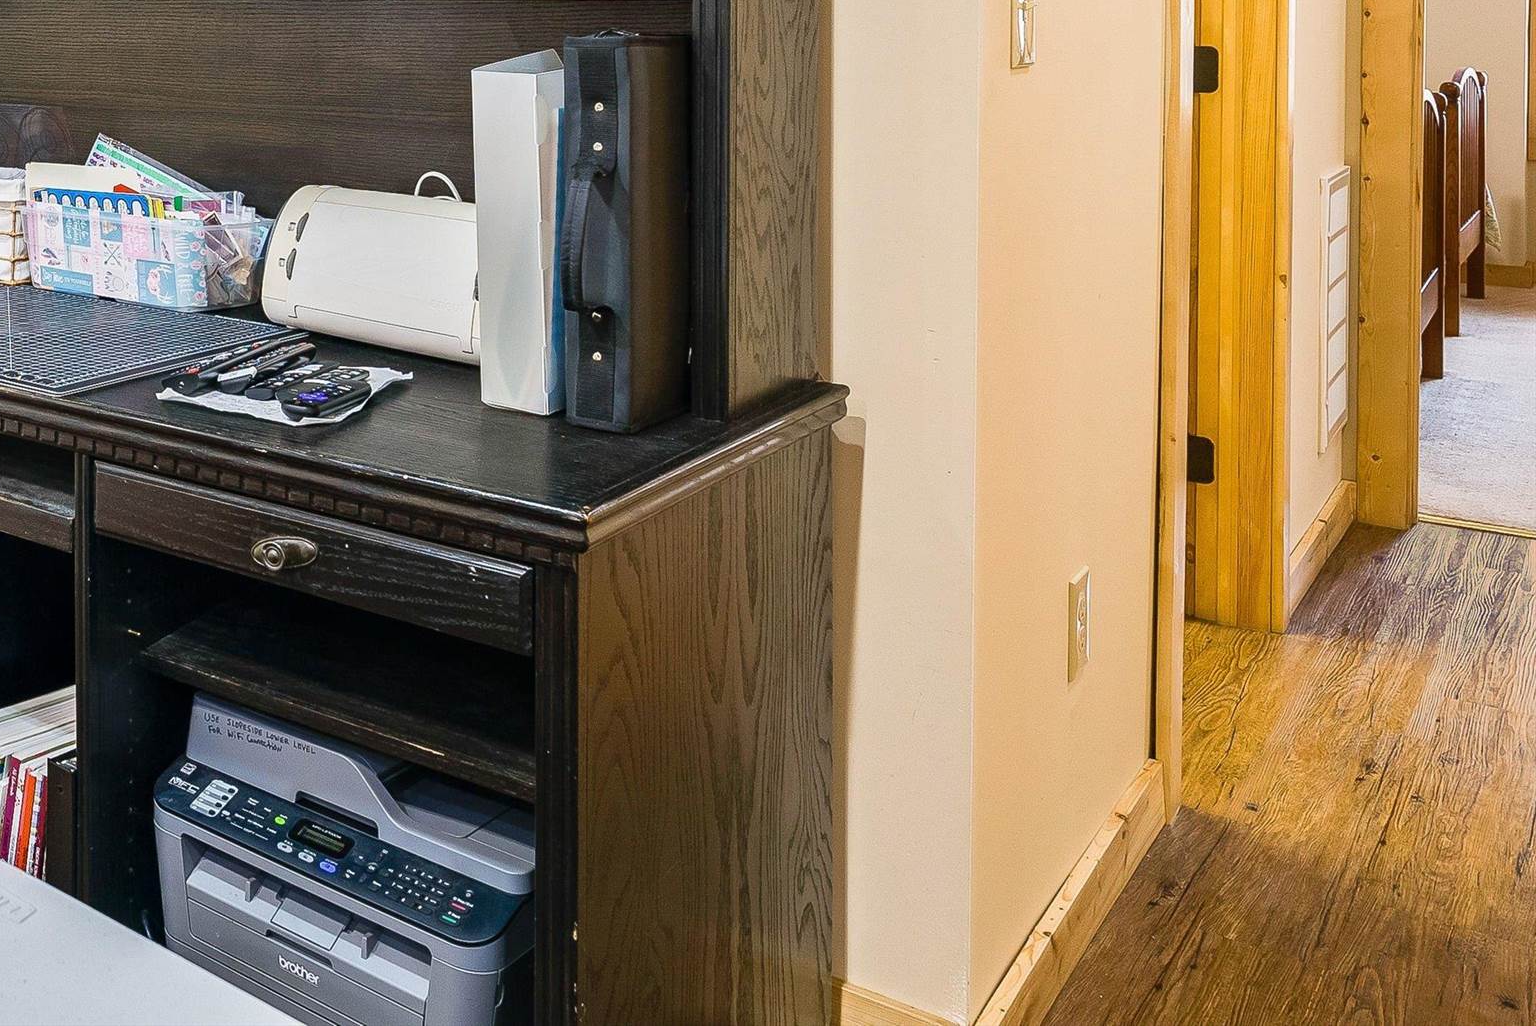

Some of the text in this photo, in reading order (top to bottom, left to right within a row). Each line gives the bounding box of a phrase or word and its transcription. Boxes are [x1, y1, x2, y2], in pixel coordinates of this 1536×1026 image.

[203, 712, 220, 724] USE
[226, 718, 263, 736] SLOPESIDE
[266, 731, 290, 745] LOWER
[167, 776, 200, 795] MFC
[278, 954, 320, 985] brother
